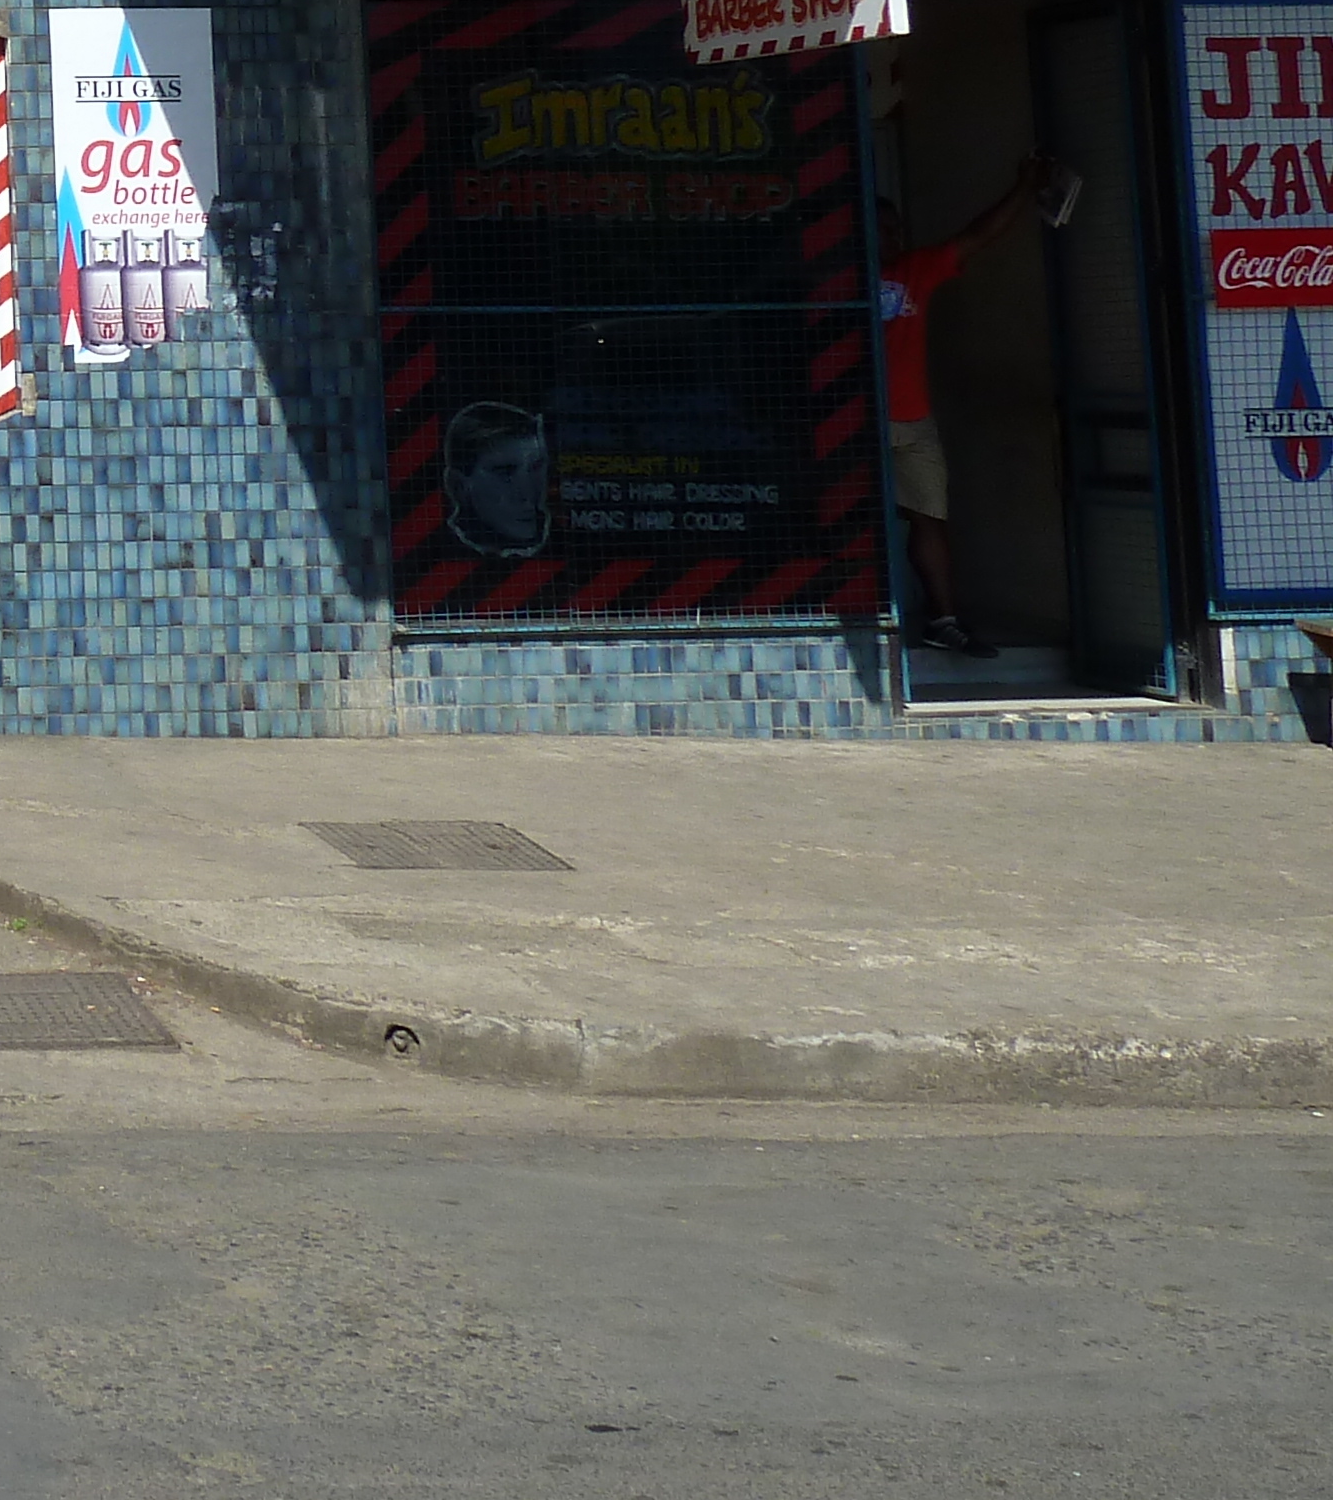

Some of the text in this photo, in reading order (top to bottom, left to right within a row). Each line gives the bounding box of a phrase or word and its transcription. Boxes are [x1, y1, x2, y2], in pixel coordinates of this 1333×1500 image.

[76, 79, 182, 99] FIJI GAS
[475, 68, 771, 164] Imraan's
[80, 138, 183, 194] gas
[113, 179, 195, 206] bottle
[454, 169, 653, 222] BARBER
[92, 211, 211, 228] exchange here
[1244, 412, 1296, 433] FIJI
[629, 481, 677, 502] HAIR
[685, 482, 780, 505] DRESSING
[633, 509, 677, 531] HAIR
[683, 509, 748, 531] COLOR
